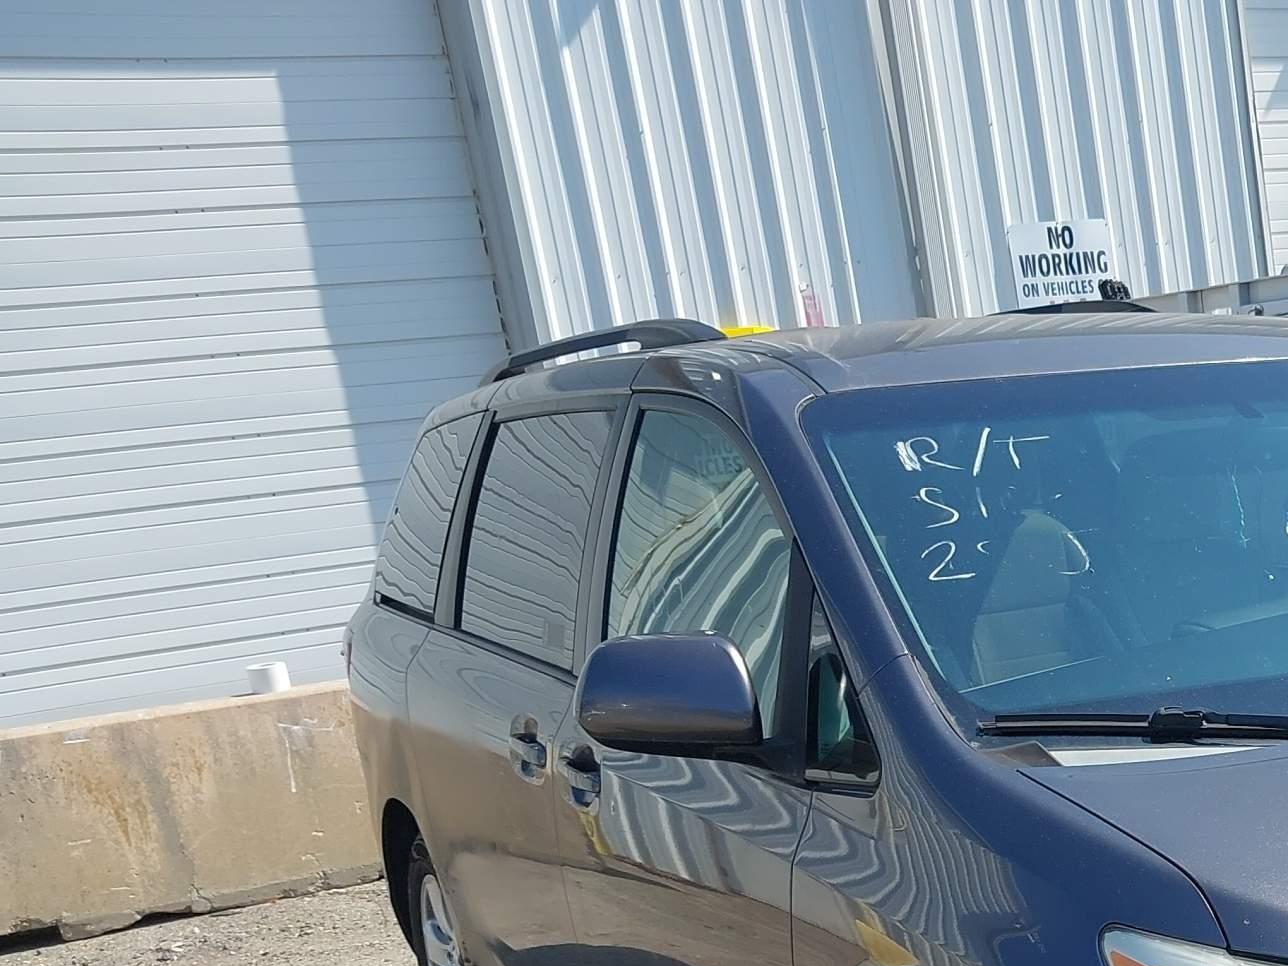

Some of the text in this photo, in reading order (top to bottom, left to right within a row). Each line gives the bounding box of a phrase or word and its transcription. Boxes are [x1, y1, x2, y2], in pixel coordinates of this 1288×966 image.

[1046, 225, 1074, 250] NO
[1018, 250, 1108, 278] WORKING
[1022, 279, 1095, 298] ON VEHICLES
